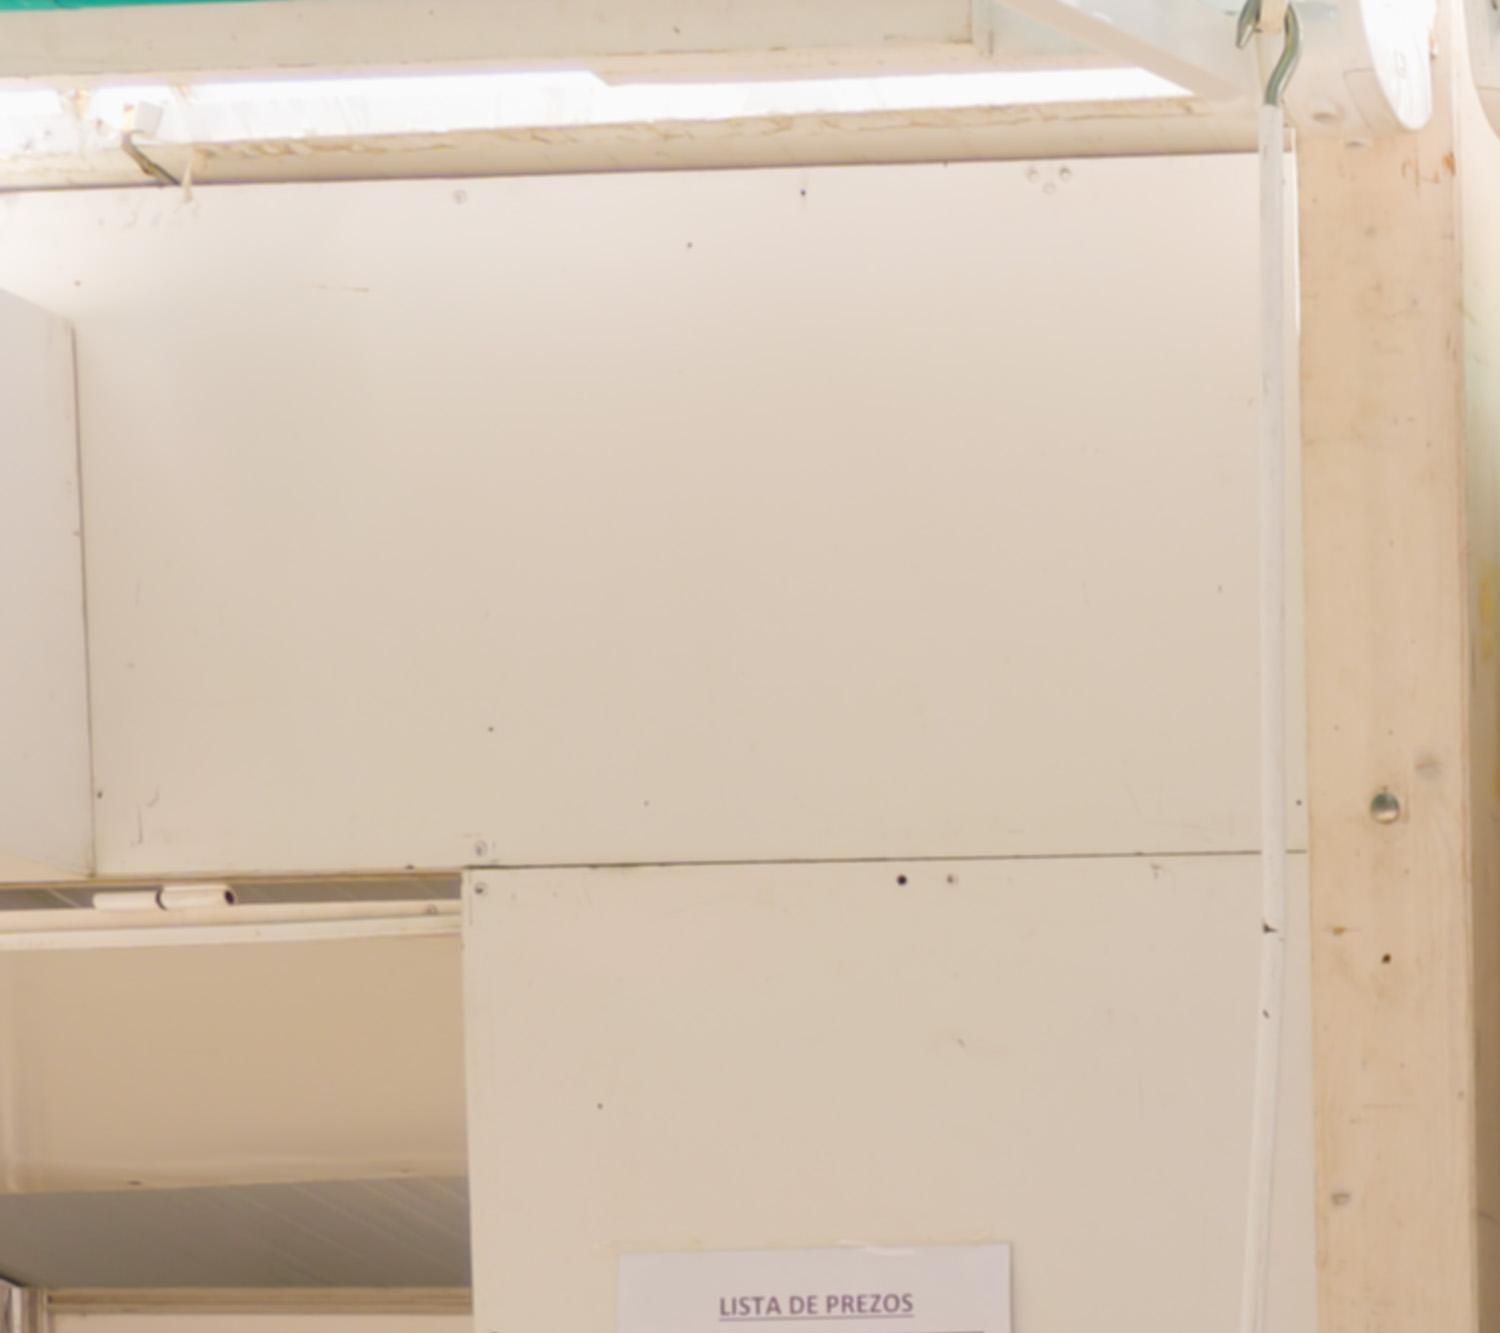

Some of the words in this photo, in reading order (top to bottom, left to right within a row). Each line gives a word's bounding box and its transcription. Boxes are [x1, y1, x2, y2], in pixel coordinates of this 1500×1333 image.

[719, 1297, 783, 1317] LISTA
[789, 1295, 819, 1316] DE
[825, 1293, 915, 1314] PREZOS
